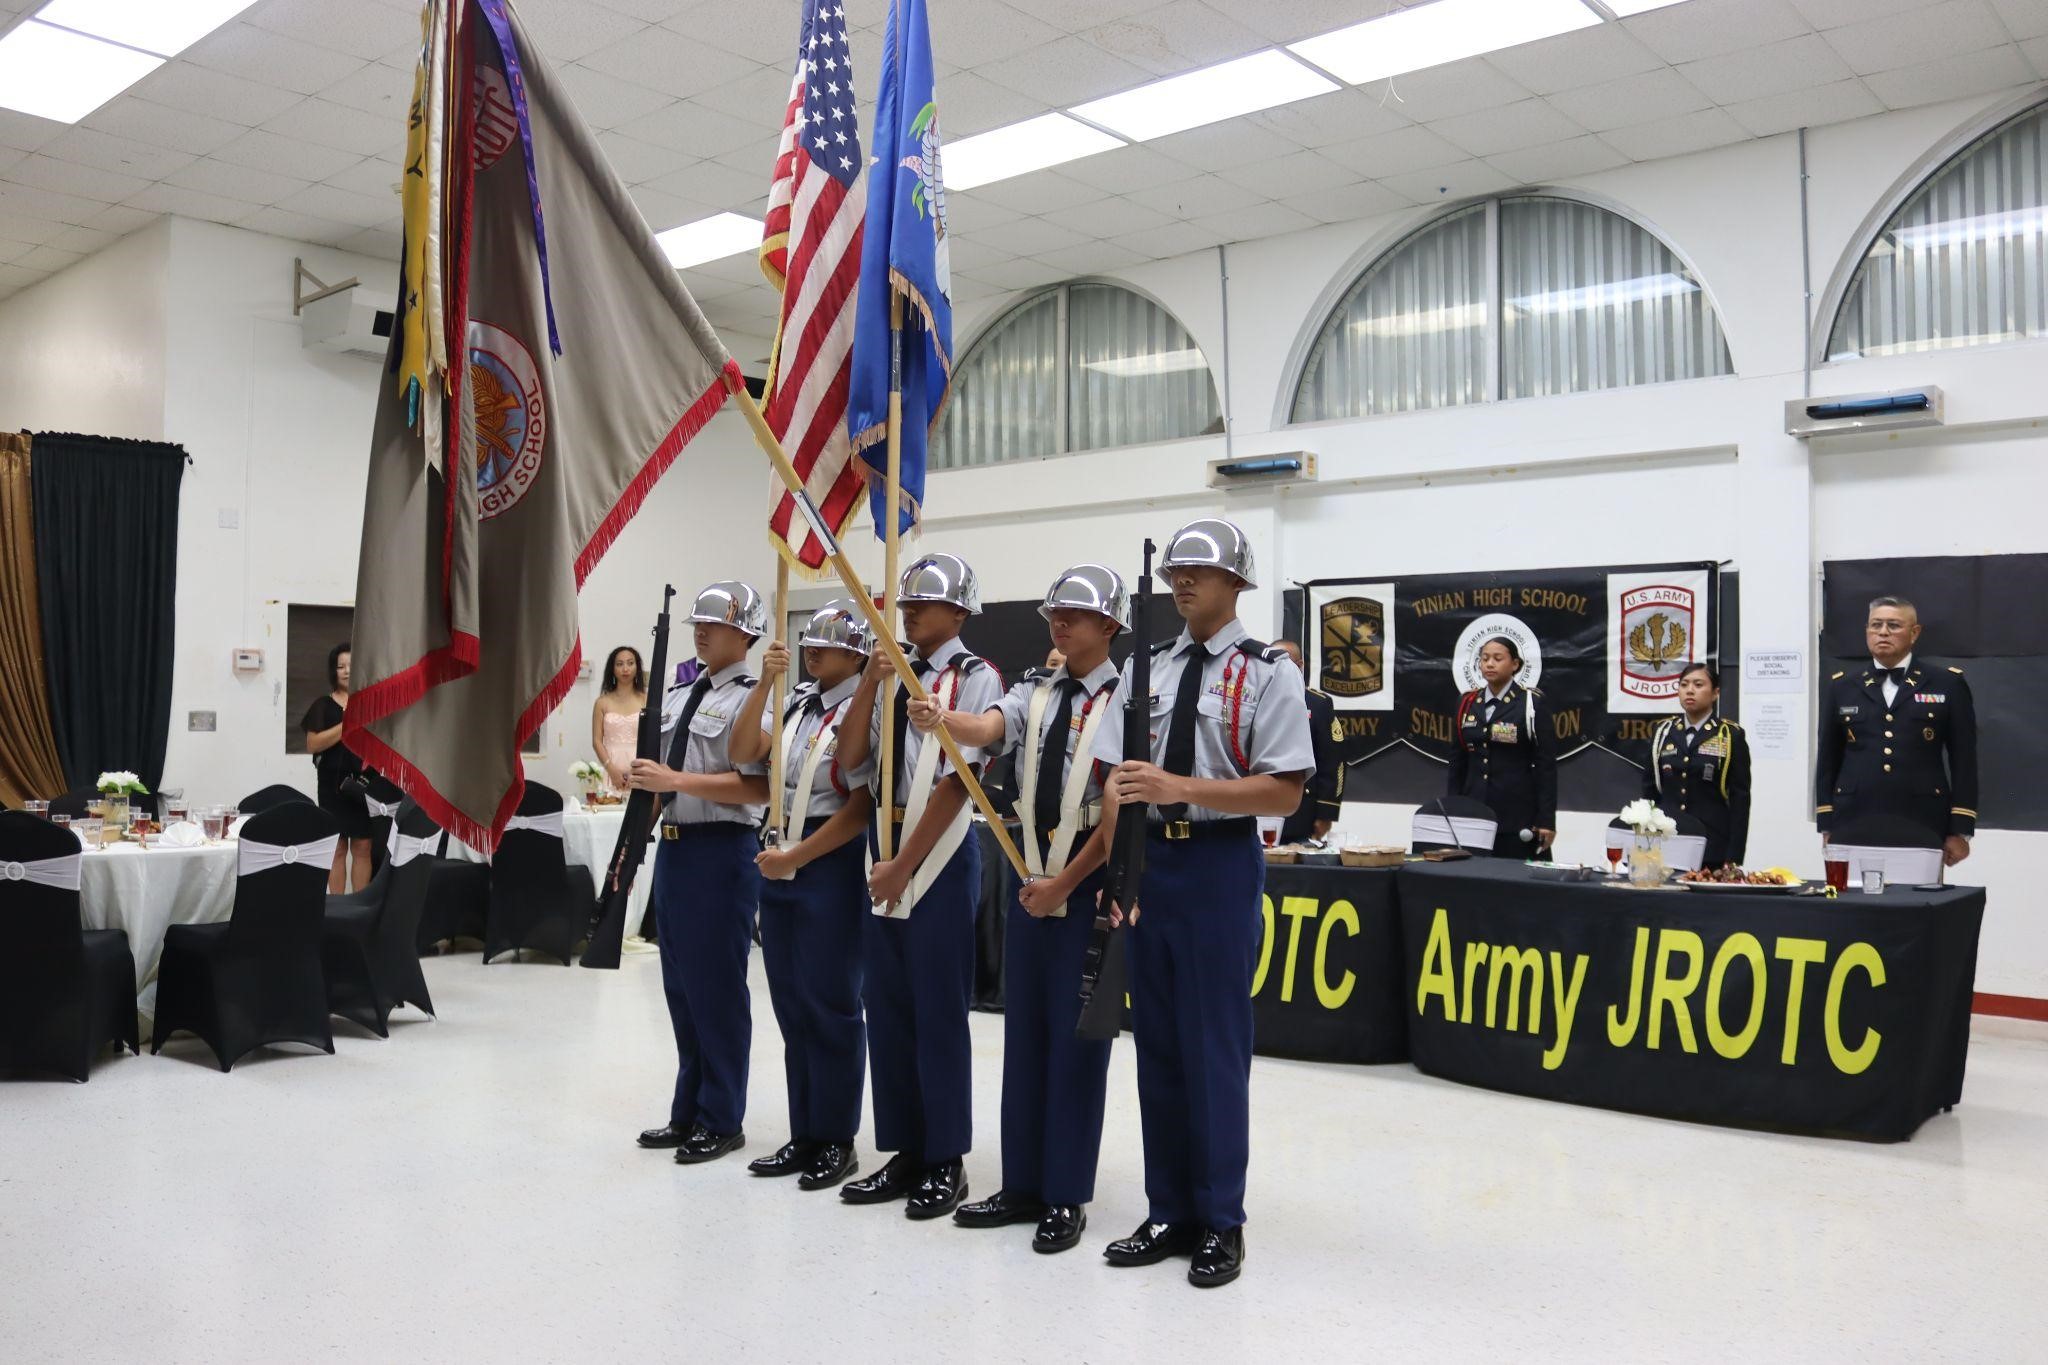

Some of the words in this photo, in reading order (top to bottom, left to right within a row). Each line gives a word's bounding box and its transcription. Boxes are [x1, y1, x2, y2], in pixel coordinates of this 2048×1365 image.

[515, 379, 541, 486] SCHOOL
[1412, 591, 1465, 618] TINIAN
[1473, 588, 1512, 606] HIGH
[1521, 588, 1589, 615] SCHOOL
[1627, 593, 1651, 606] U.S.
[1655, 590, 1689, 604] ARMY
[1324, 601, 1380, 617] LEADERSHIP
[1468, 630, 1486, 649] TINIAN
[1505, 627, 1527, 646] SCHOOL
[1324, 680, 1380, 693] EXCELLENCE
[1339, 716, 1380, 737] RMY
[1417, 908, 1590, 1071] Army
[1607, 926, 1887, 1075] JROTC
